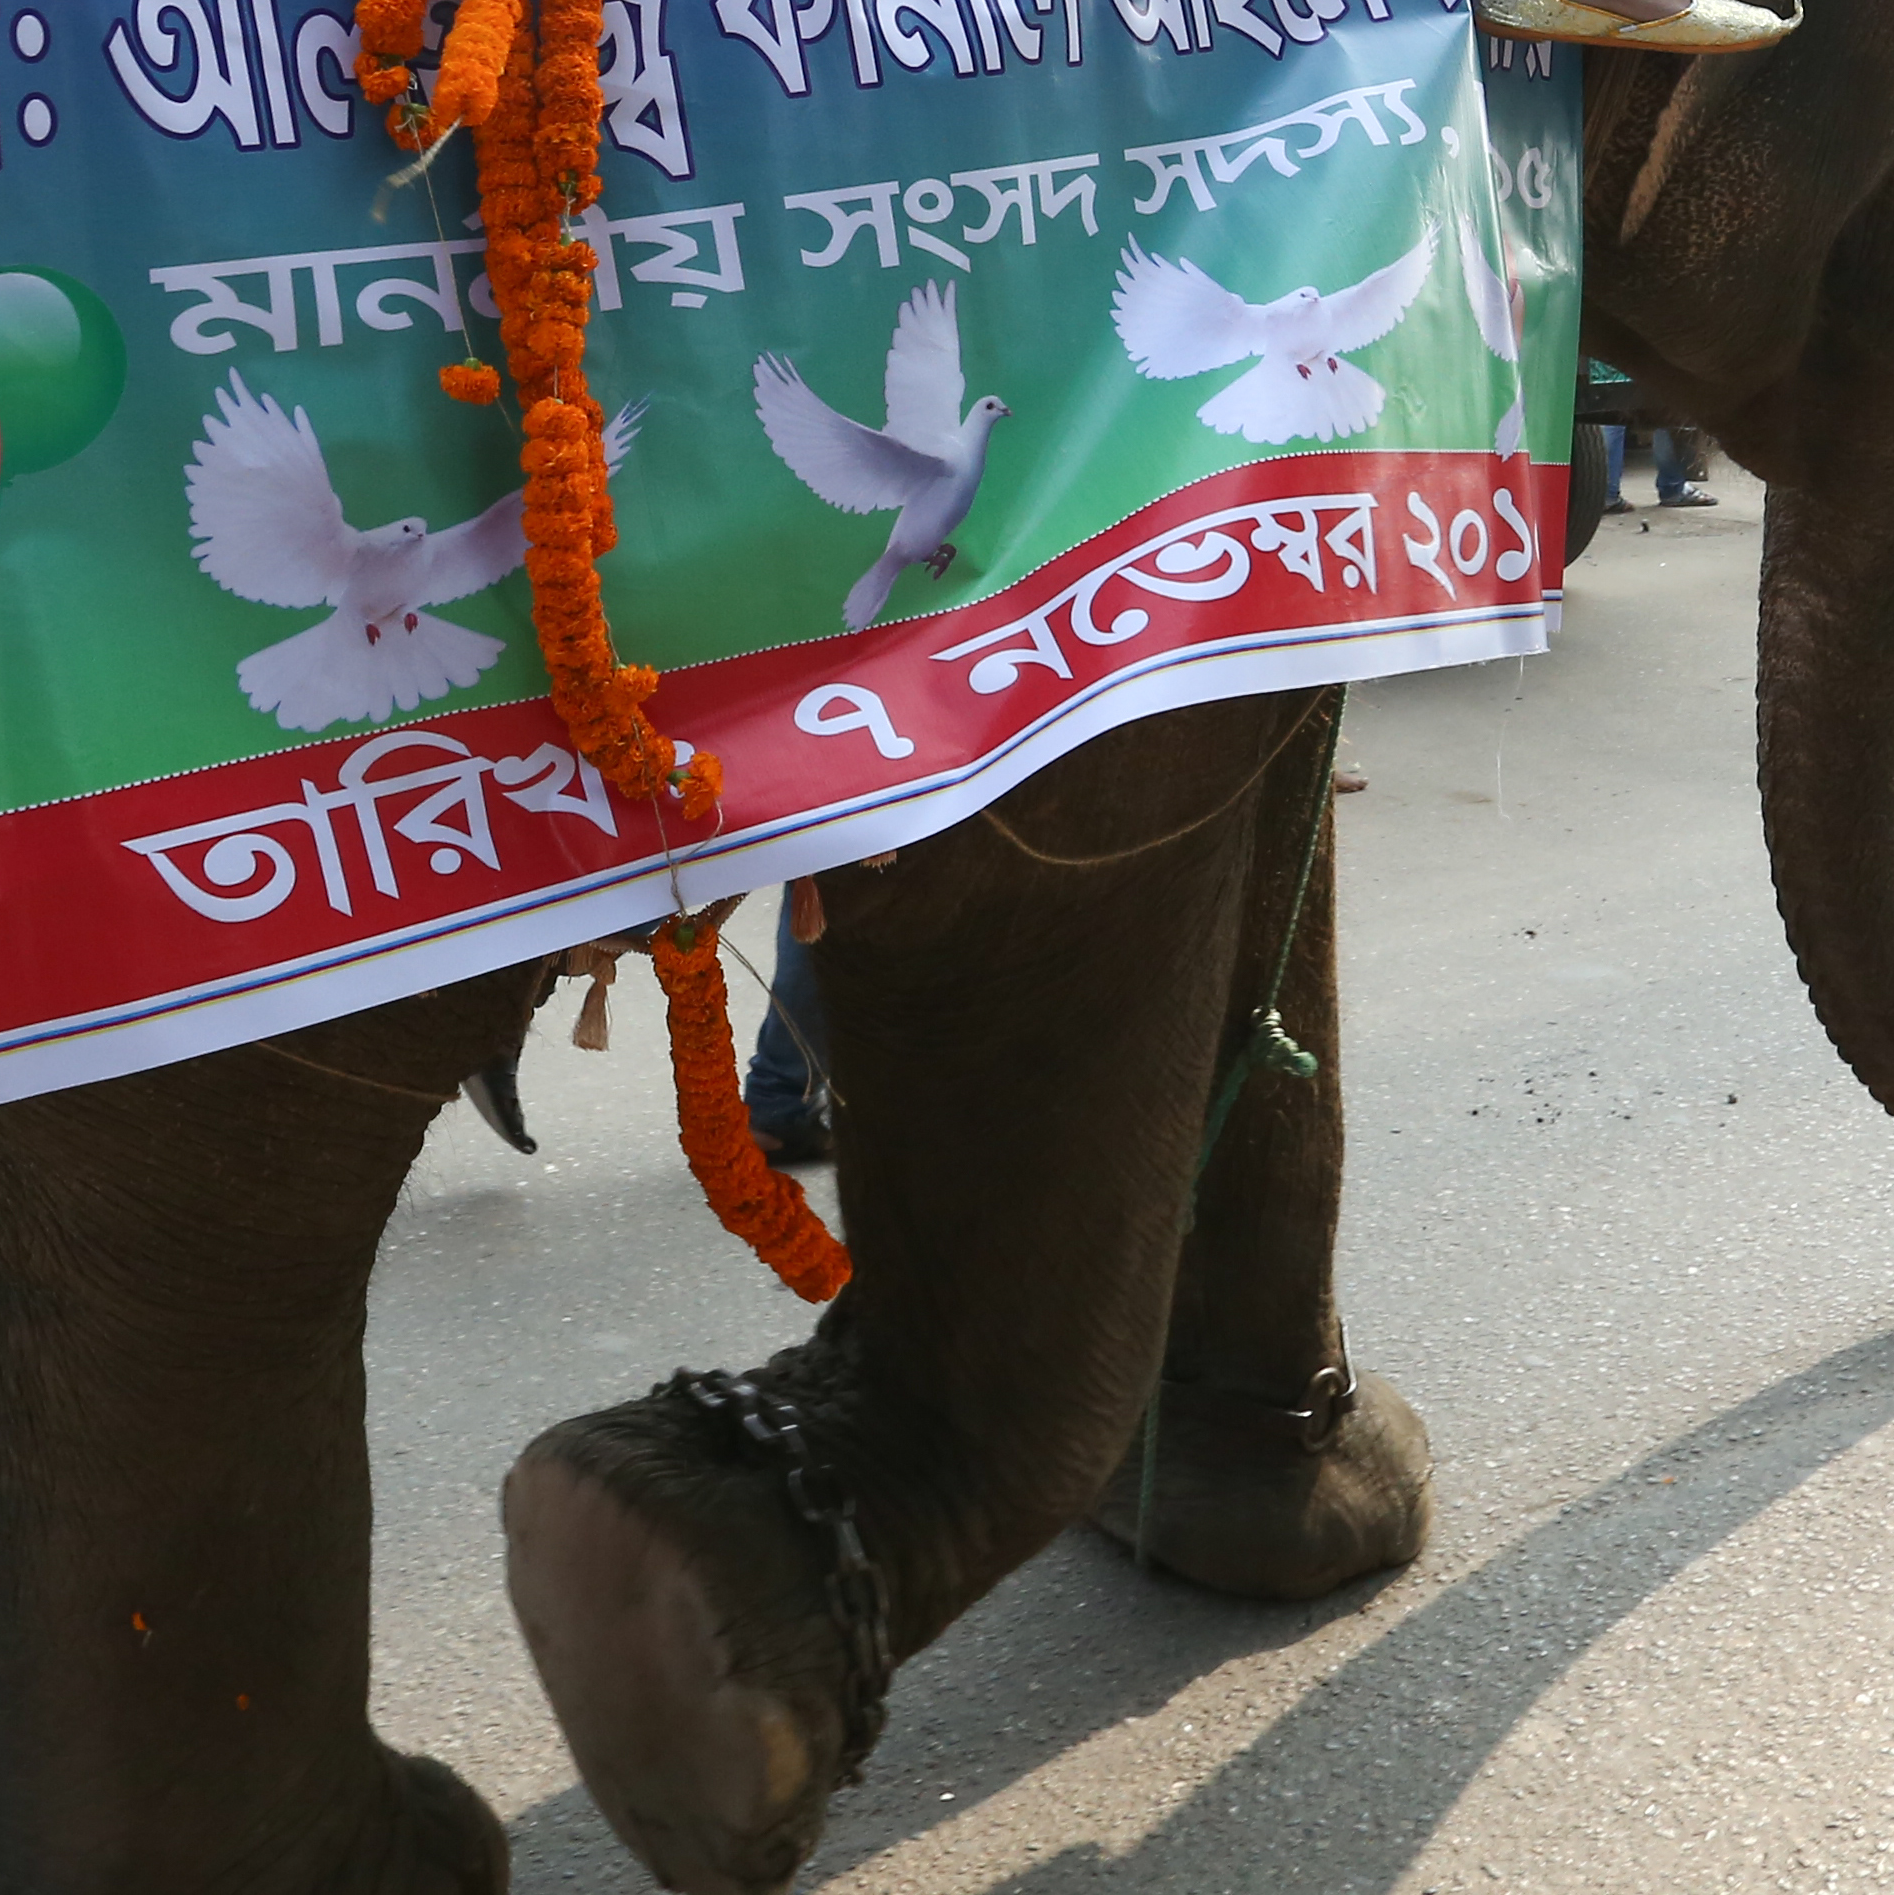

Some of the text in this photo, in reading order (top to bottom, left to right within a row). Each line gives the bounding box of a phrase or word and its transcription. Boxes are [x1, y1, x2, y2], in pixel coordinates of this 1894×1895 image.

[784, 152, 1100, 273] সংসদ
[792, 680, 914, 762] ৭
[928, 492, 1379, 696] নভেম্বর
